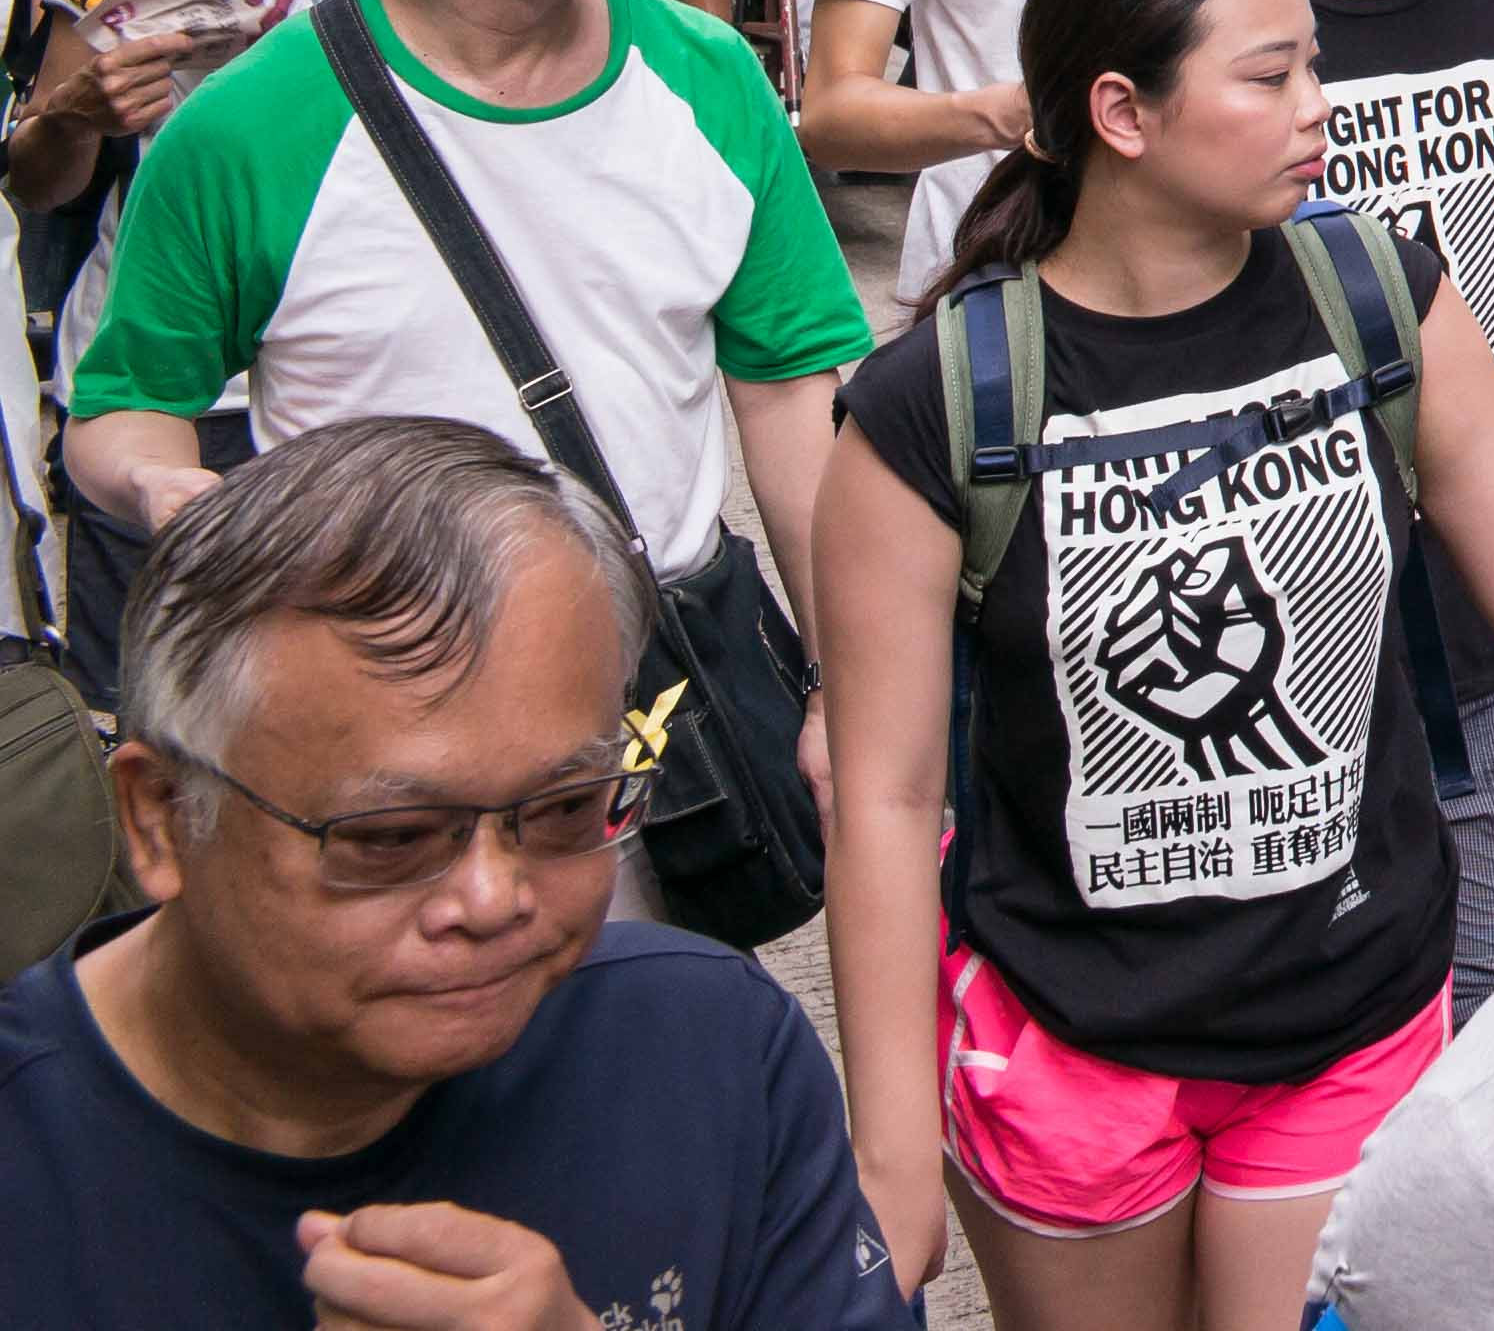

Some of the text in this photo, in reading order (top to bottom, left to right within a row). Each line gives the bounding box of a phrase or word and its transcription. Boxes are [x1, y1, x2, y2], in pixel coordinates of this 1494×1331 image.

[1323, 78, 1493, 147] GHT FOR
[1060, 473, 1208, 537] HONG
[1221, 430, 1363, 514] KONG
[1086, 790, 1231, 846] 一國兩制
[1088, 838, 1234, 895] 民主自治
